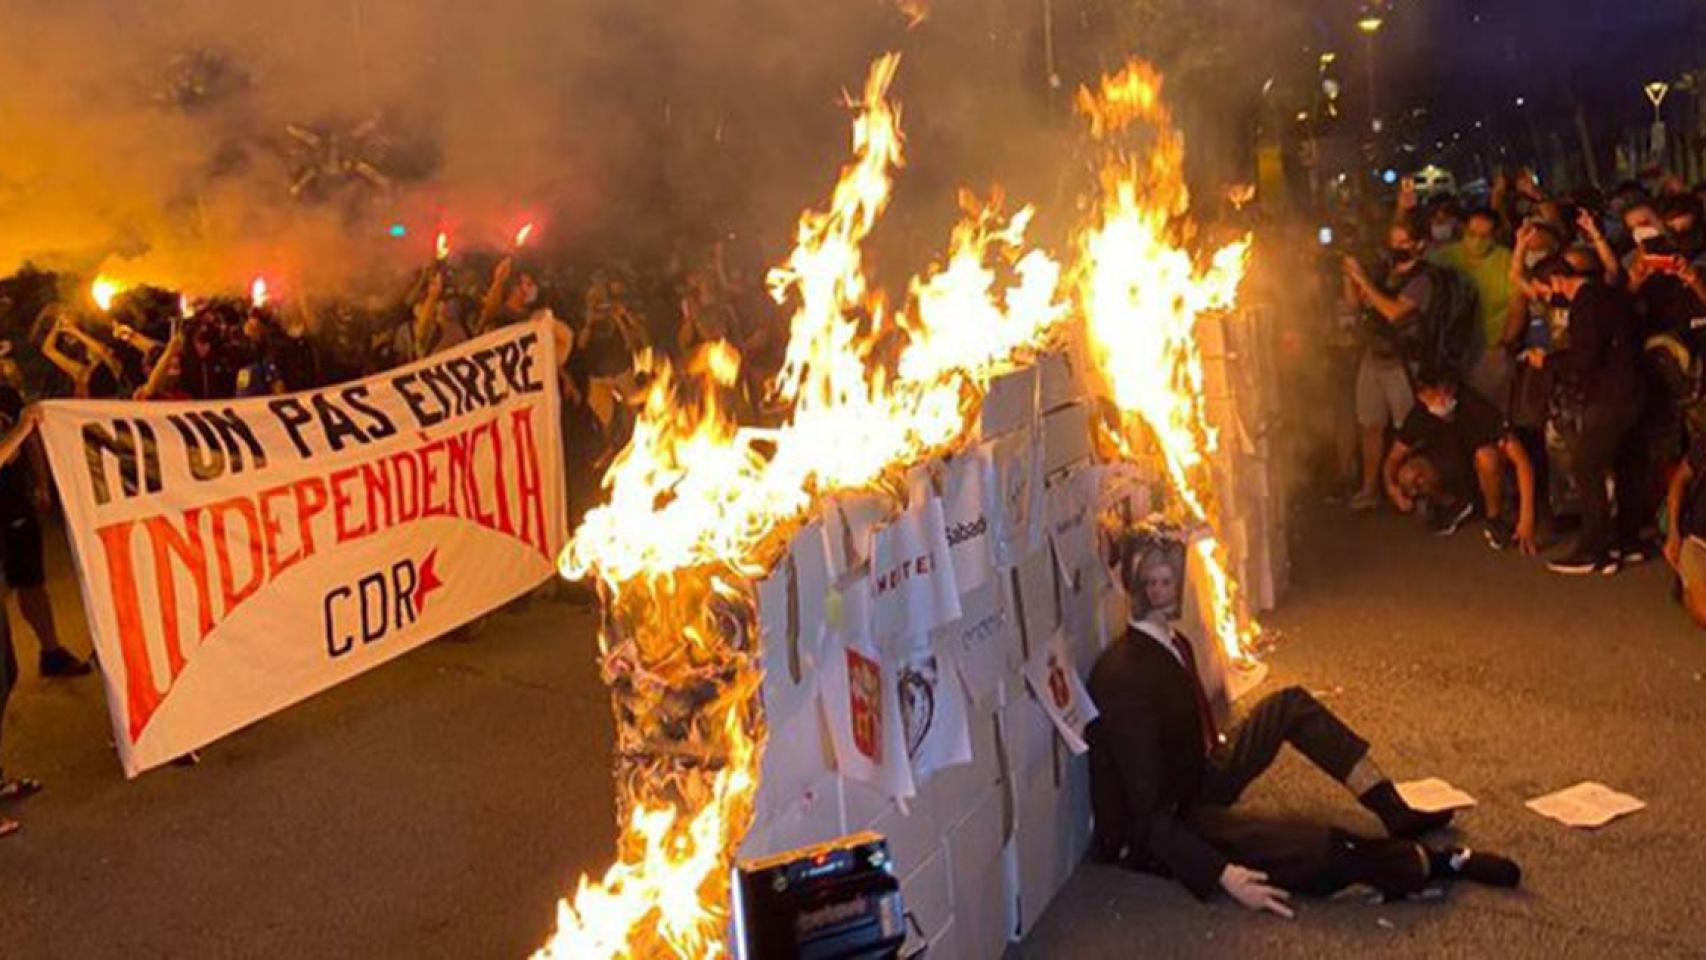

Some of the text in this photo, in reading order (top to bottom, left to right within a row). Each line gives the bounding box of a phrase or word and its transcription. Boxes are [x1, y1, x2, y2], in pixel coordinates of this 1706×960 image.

[82, 418, 163, 505] NI
[166, 408, 267, 481] UN
[268, 386, 396, 458] PAS
[95, 404, 551, 744] INDEPENDÈNCIA
[323, 558, 417, 659] CDR
